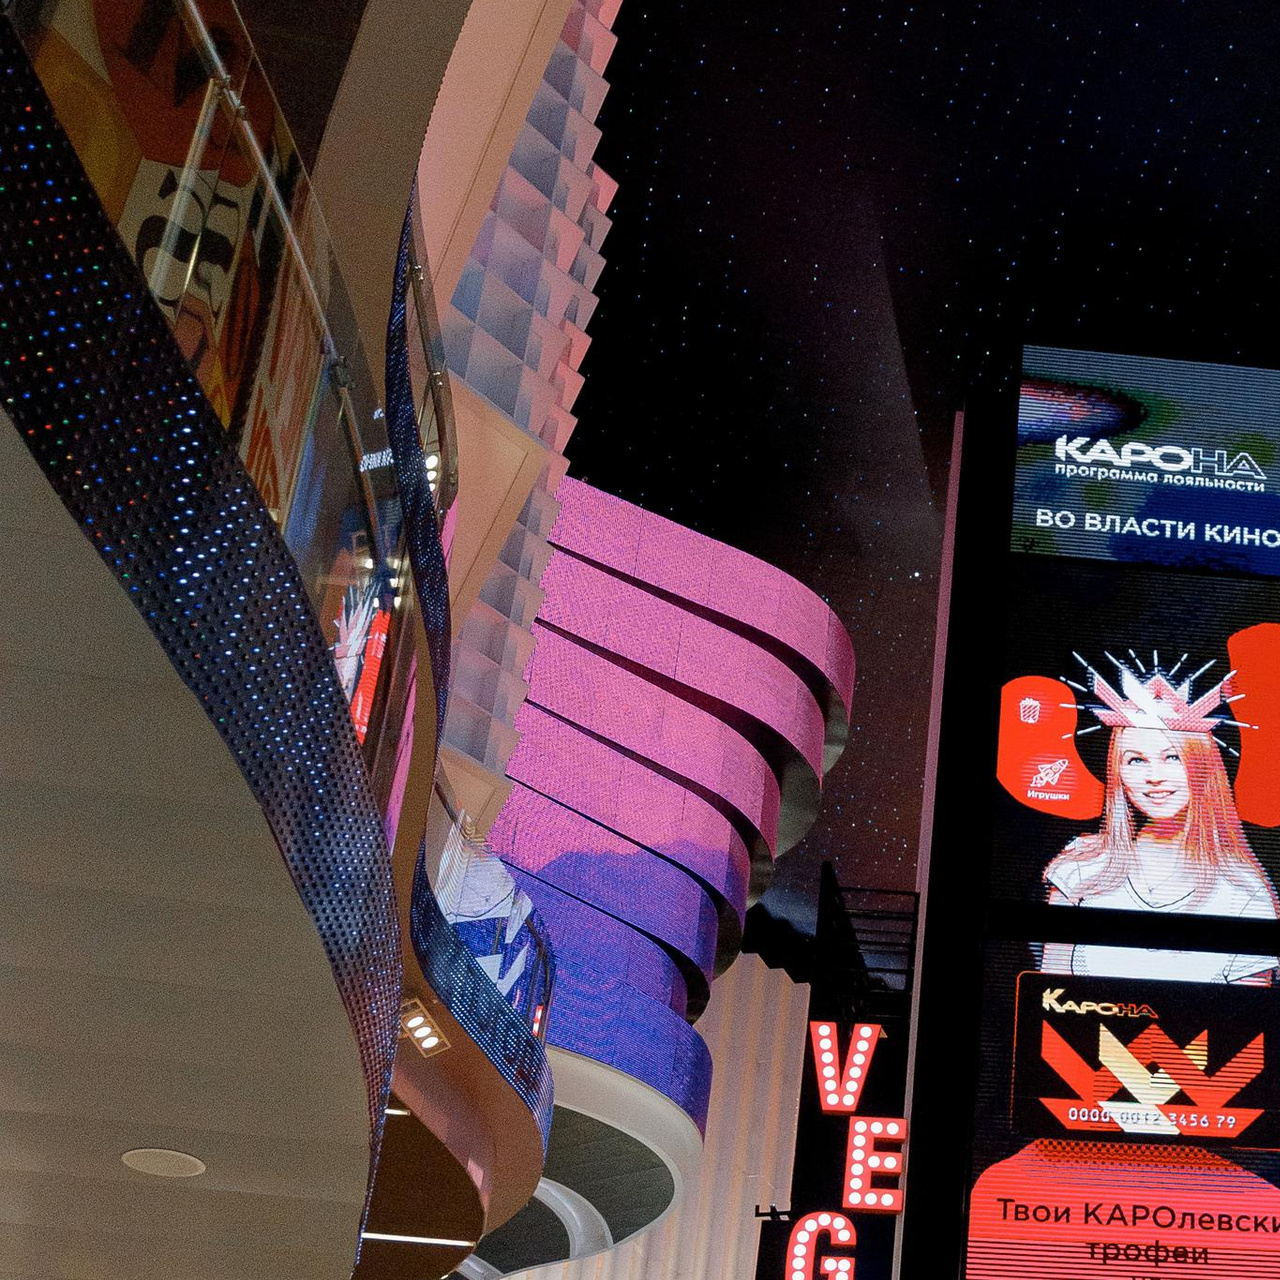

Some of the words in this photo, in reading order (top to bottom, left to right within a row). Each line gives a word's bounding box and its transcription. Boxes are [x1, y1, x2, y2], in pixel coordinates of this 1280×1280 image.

[1055, 434, 1267, 480] КАРОНА
[1055, 463, 1158, 481] программа
[1163, 474, 1265, 493] лояльности
[1036, 508, 1076, 529] ВО
[1084, 512, 1196, 540] ВЛАСТИ
[1027, 789, 1070, 802] Игрушки
[1068, 1106, 1112, 1122] 0000
[1169, 1113, 1210, 1128] 3456
[1216, 1114, 1236, 1128] 79
[997, 1198, 1071, 1225] Твои
[1086, 1240, 1210, 1266] трофеи
